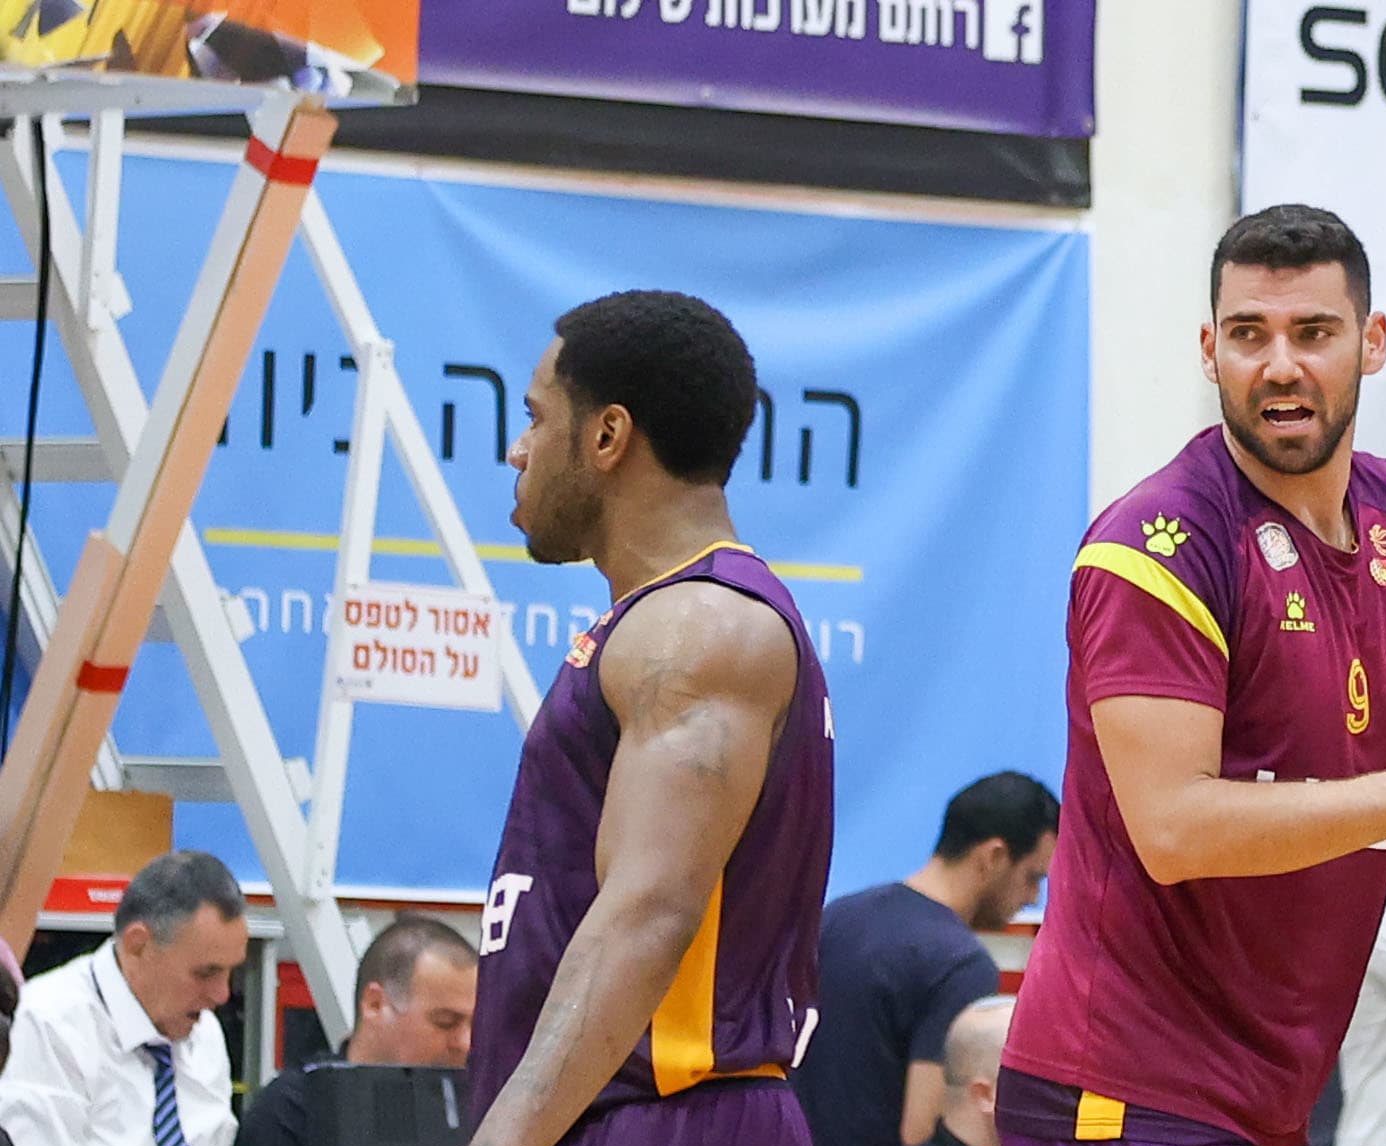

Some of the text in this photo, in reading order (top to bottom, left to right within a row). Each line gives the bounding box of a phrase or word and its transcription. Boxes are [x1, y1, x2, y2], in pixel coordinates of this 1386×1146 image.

[345, 598, 420, 631] לטפס
[427, 606, 490, 637] אסור
[353, 638, 479, 679] על הסולם
[1346, 658, 1370, 735] 9
